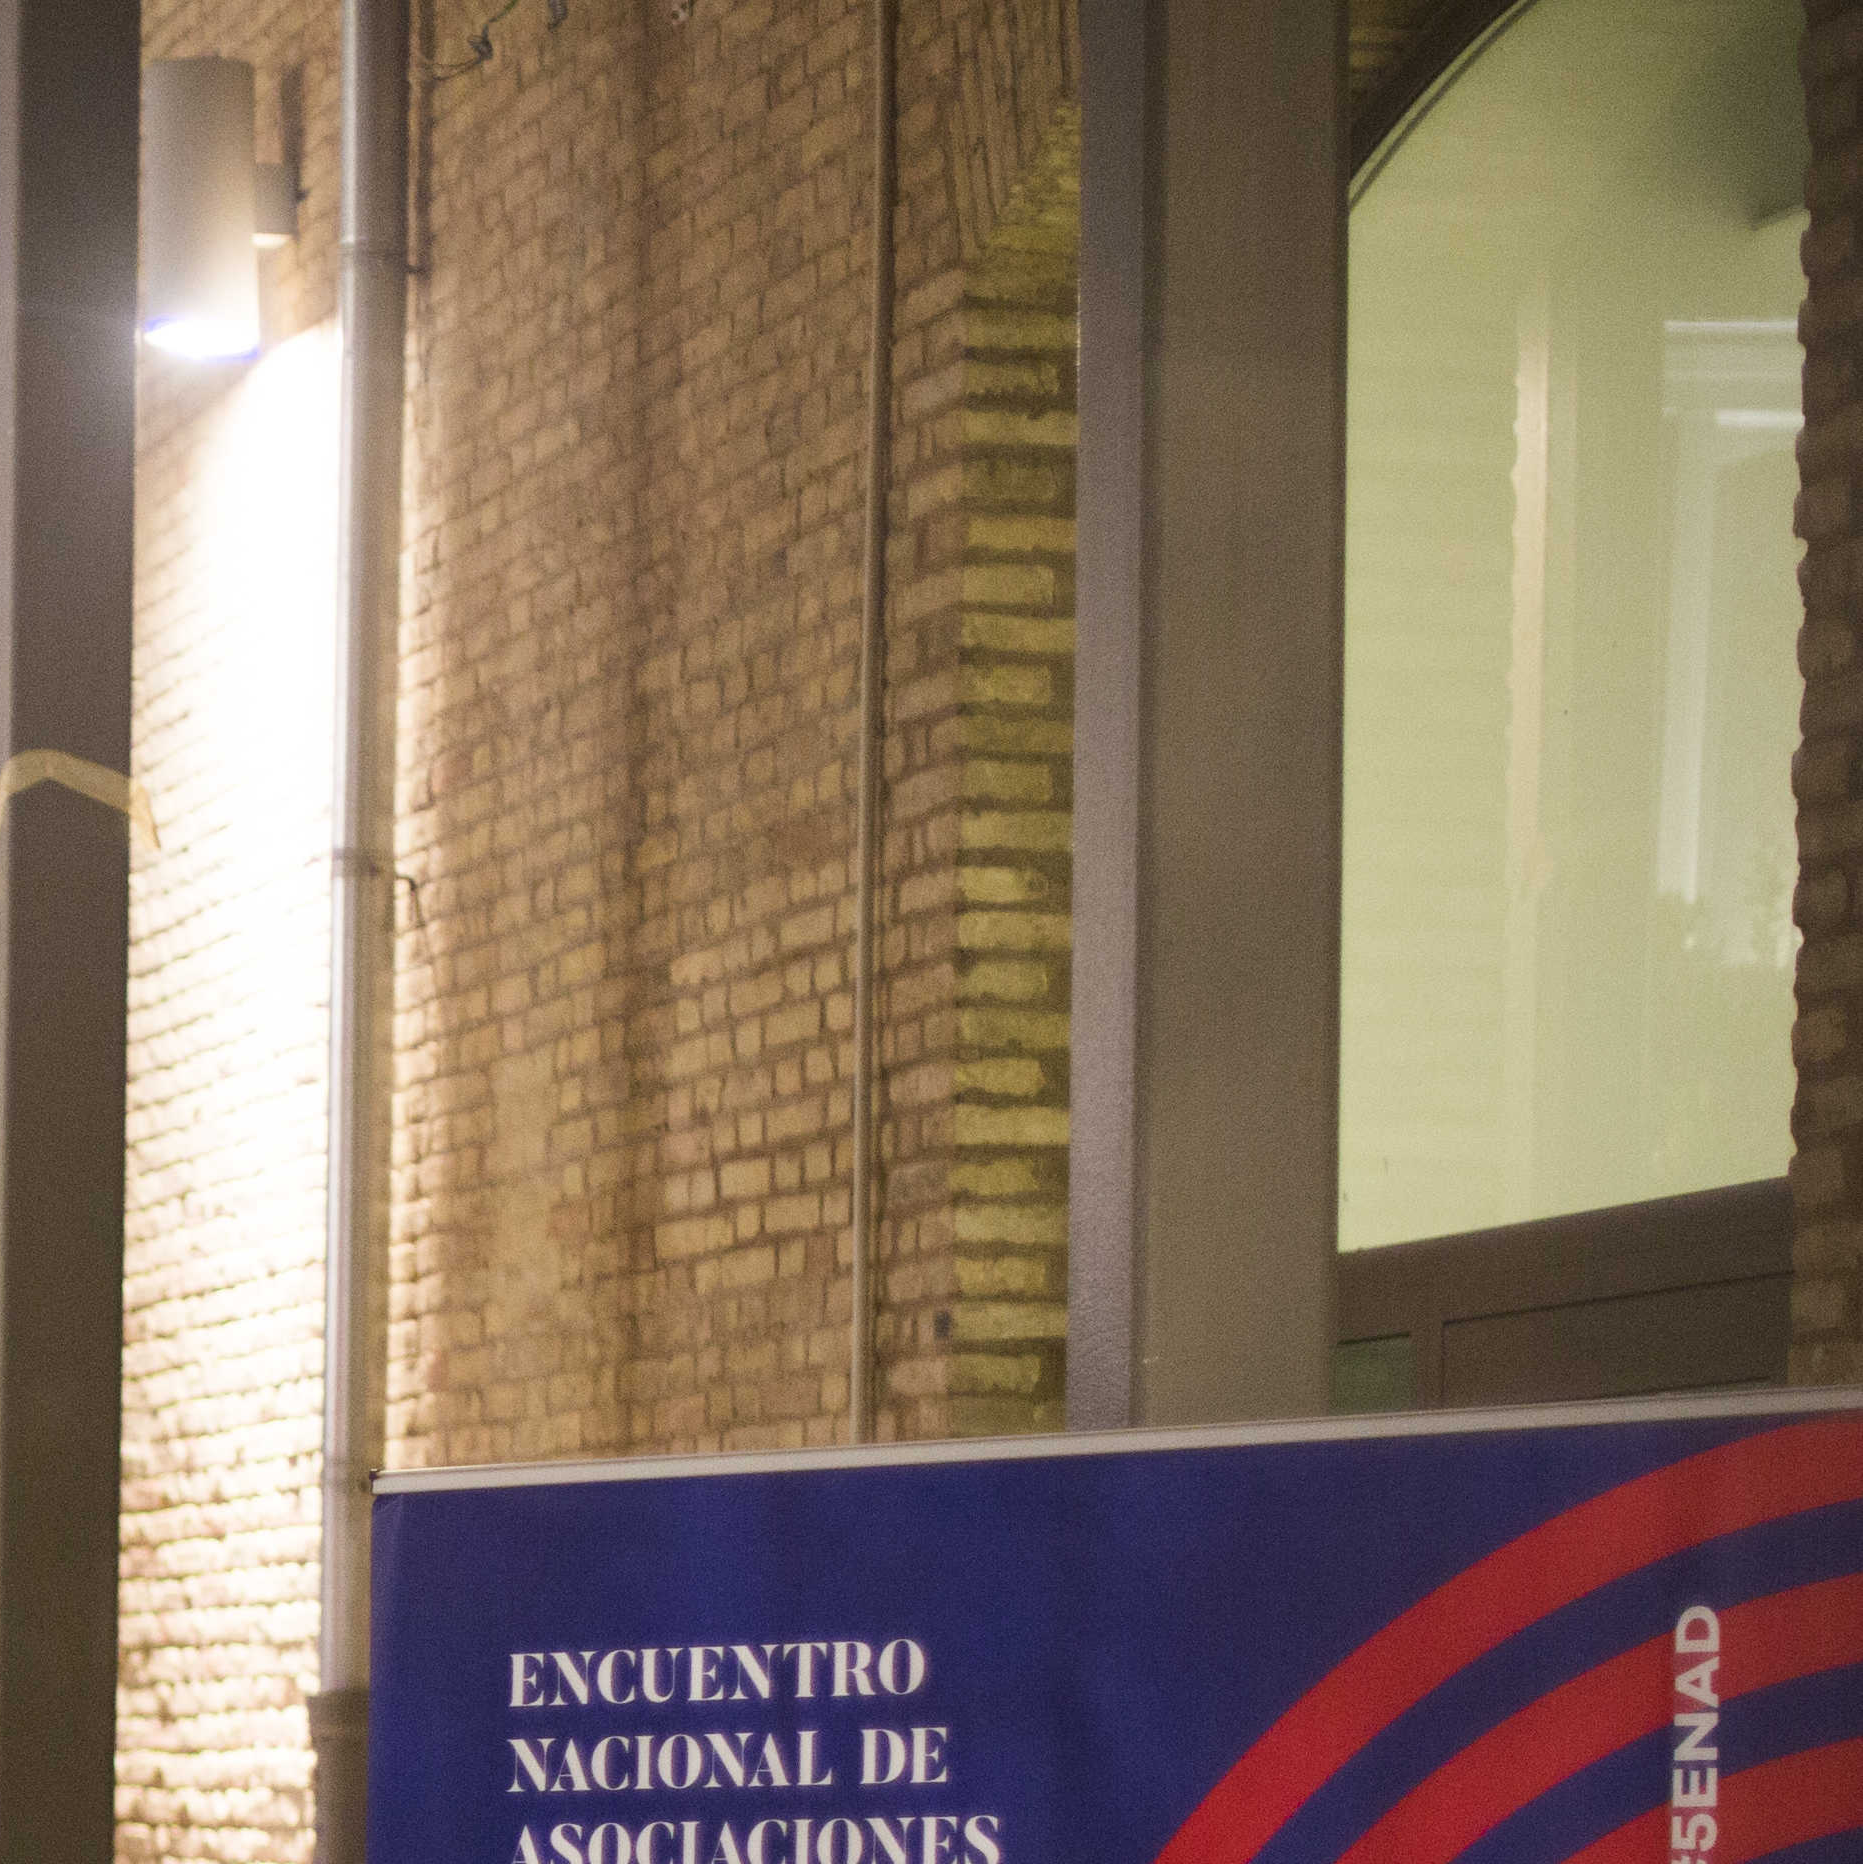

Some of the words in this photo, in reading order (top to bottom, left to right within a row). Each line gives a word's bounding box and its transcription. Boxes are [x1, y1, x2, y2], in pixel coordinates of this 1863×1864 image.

[509, 1639, 926, 1707] ENCUENTRO
[506, 1730, 833, 1792] NACIONAL
[859, 1726, 949, 1785] DE
